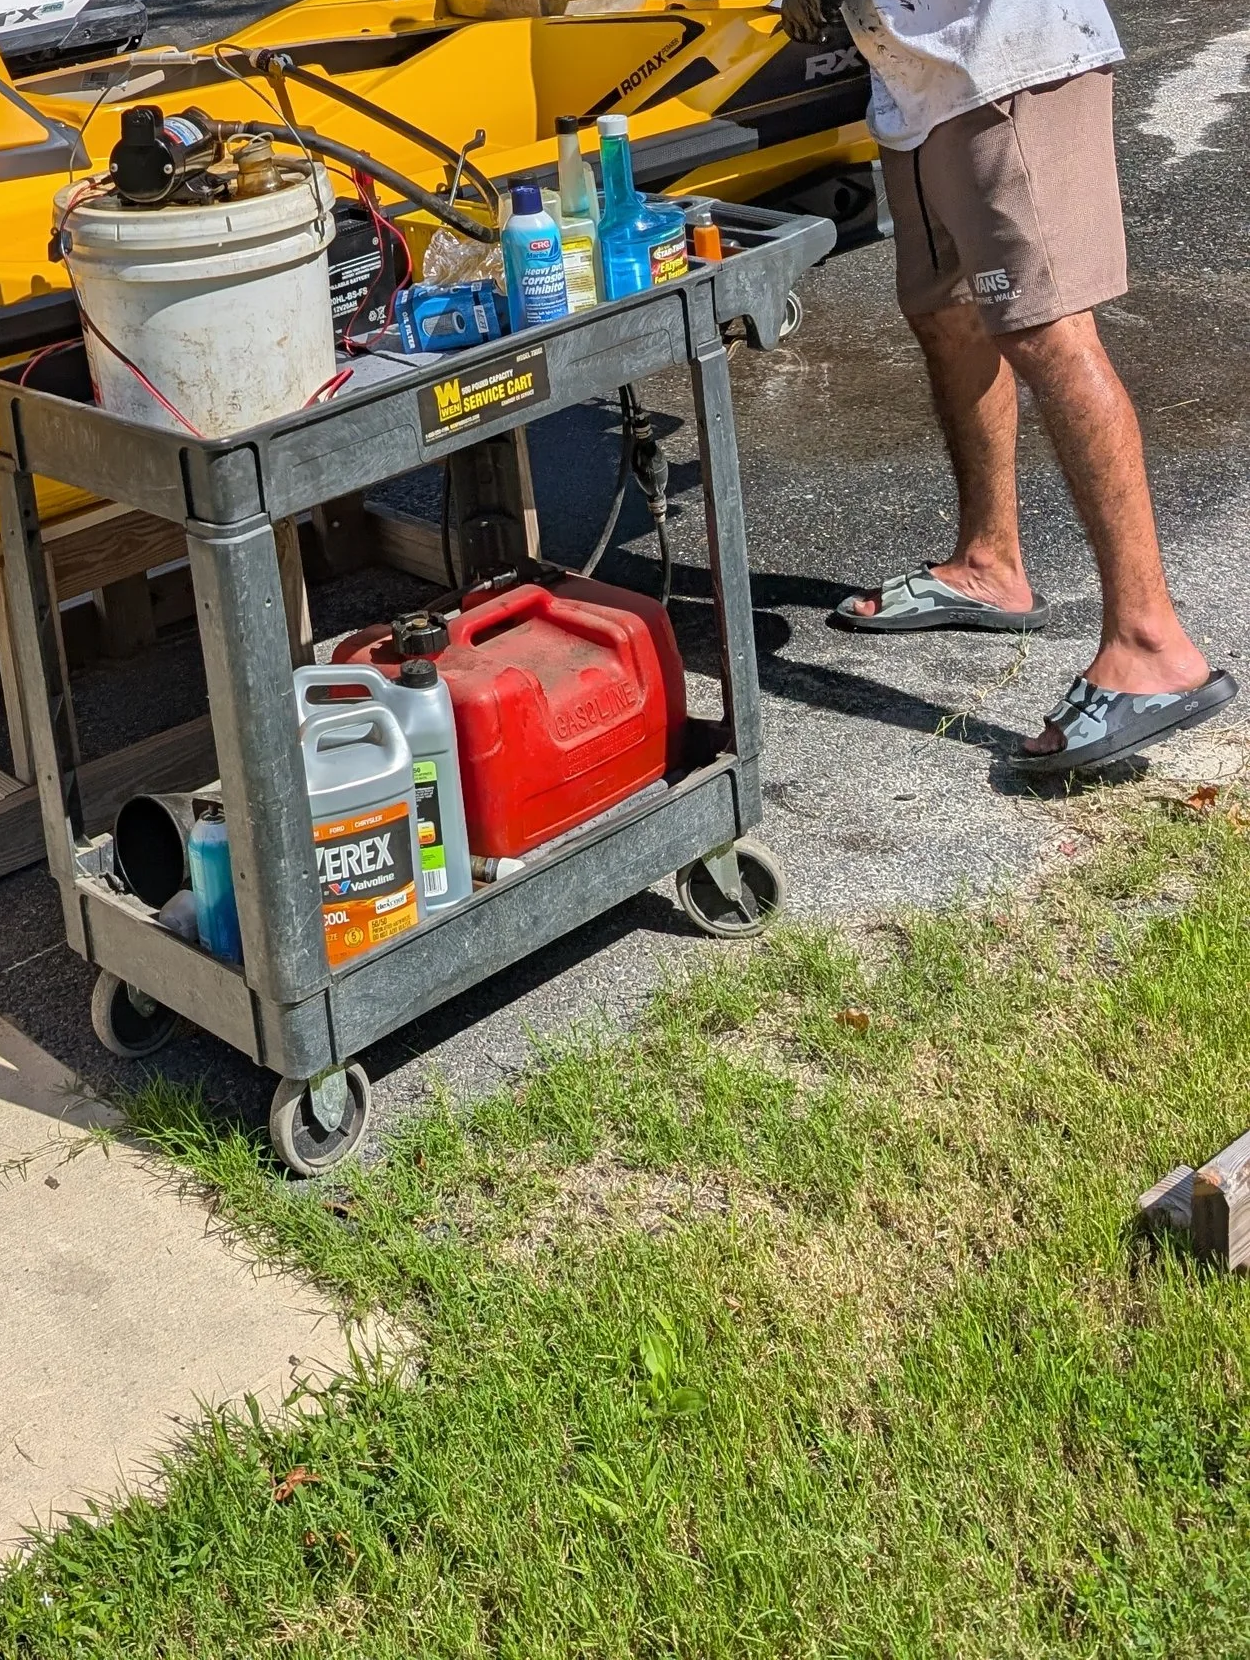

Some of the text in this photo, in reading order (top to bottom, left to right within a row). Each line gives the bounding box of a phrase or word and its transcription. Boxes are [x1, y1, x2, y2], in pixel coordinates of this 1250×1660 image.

[619, 38, 679, 96] ROTAX POWER
[530, 240, 550, 250] CRC
[521, 271, 564, 286] Corrosion
[524, 265, 550, 276] Heavy
[524, 281, 565, 295] Inhibitor
[973, 268, 1010, 293] VANS
[472, 378, 489, 391] POUND
[489, 369, 514, 384] CAPACITY
[463, 372, 533, 412] SERVICE CART
[440, 404, 462, 418] WEN
[554, 680, 637, 739] GASOLINE
[329, 825, 345, 834] FORD
[354, 815, 383, 828] CHRYSLER
[351, 872, 395, 892] Valvoline
